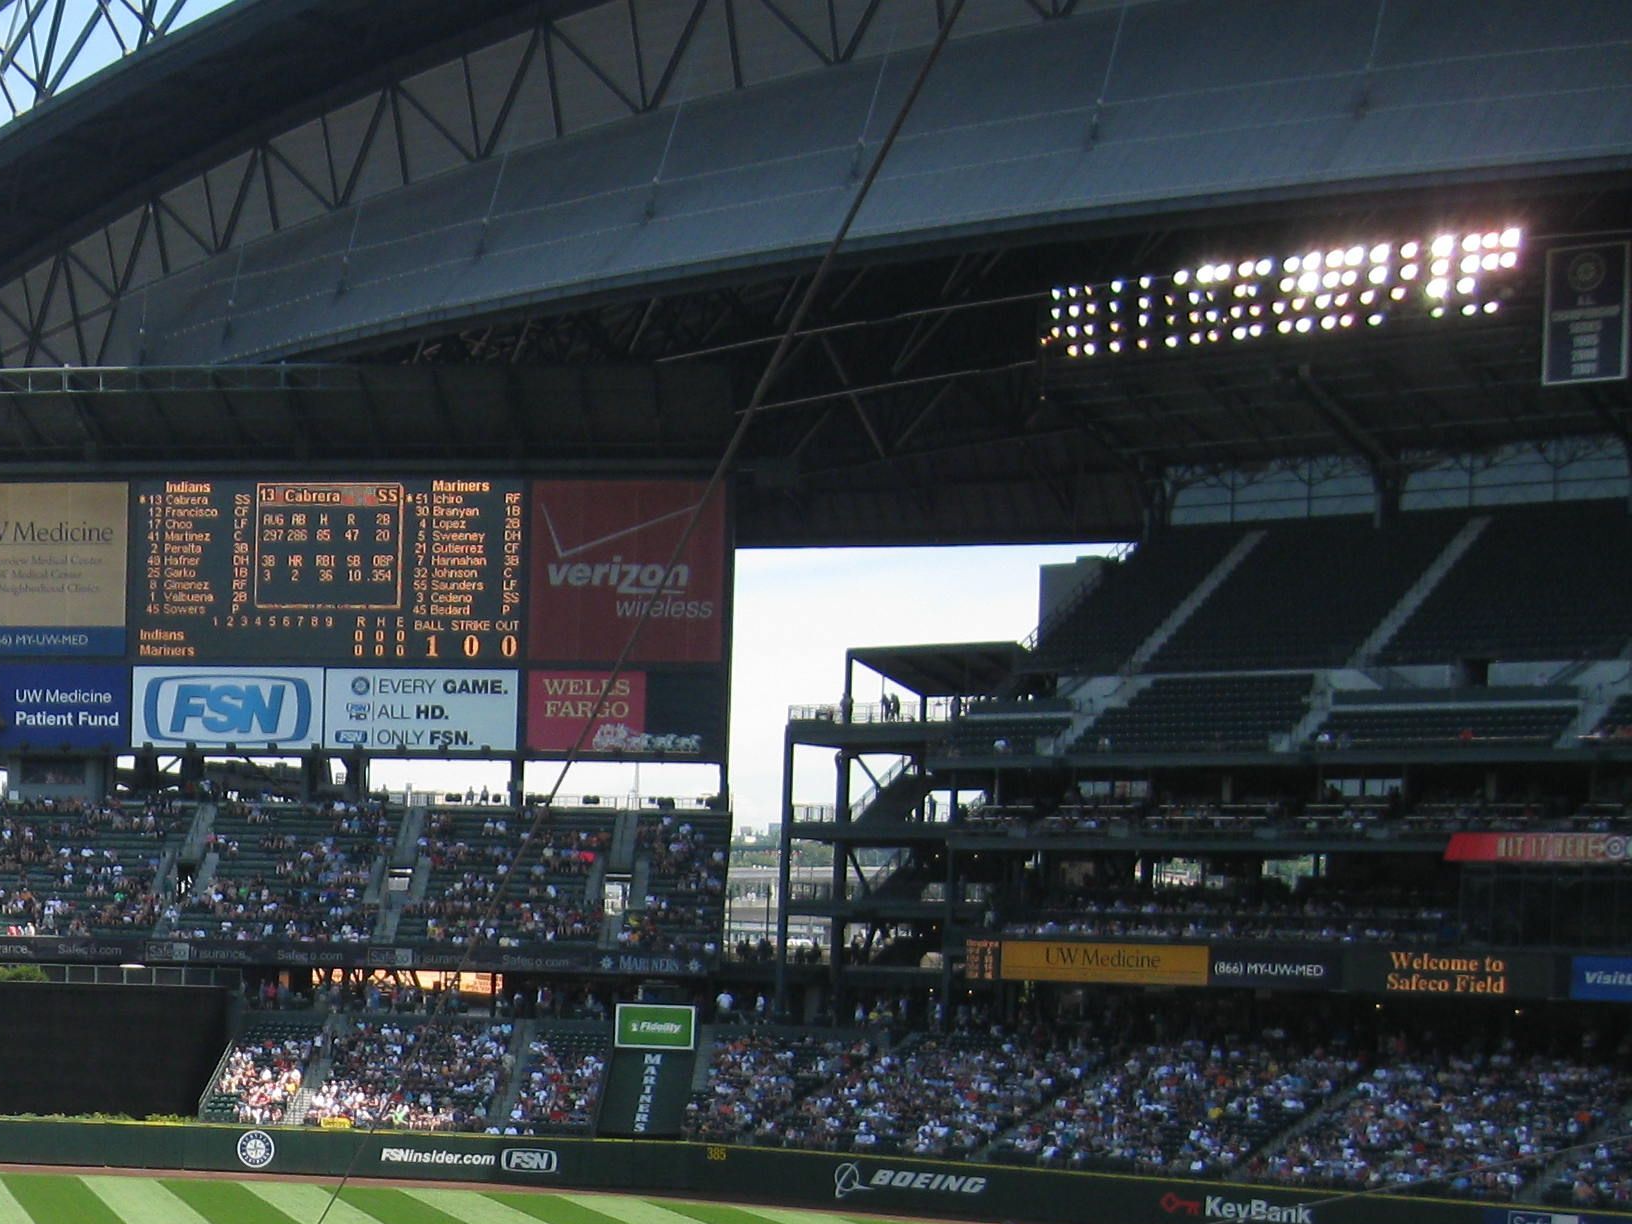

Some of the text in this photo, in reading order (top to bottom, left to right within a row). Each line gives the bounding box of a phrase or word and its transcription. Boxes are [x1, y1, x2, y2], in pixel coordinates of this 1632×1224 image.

[165, 481, 211, 493] Indians
[432, 480, 490, 492] Mariners
[260, 488, 398, 503] 13 Cabrera SS
[433, 493, 463, 504] Ichiro
[165, 507, 218, 517] Francisco
[432, 506, 479, 518] Branyan
[165, 519, 193, 529] Choo
[291, 514, 307, 526] AB
[432, 518, 466, 530] Lopez
[13, 521, 113, 542] Medicine
[164, 531, 211, 542] Martinez
[344, 529, 359, 541] 47
[375, 530, 390, 541] 20
[432, 531, 485, 542] Sweeney
[432, 543, 483, 554] Gutierrez
[164, 555, 200, 566] Hafner
[288, 555, 303, 567] HR
[315, 555, 336, 567] RBI
[346, 555, 361, 566] SB
[373, 555, 394, 566] OBP
[431, 555, 486, 566] Hannahan
[164, 568, 196, 578] Garko
[319, 570, 333, 581] 36
[348, 569, 362, 581] 10
[432, 568, 477, 579] Johnson
[547, 557, 690, 594] verizon
[431, 580, 484, 591] Saunders
[163, 604, 206, 614] Sowers
[430, 604, 470, 615] Bedard
[616, 597, 713, 618] wireless
[414, 620, 519, 631] BALL STRIKE OUT
[15, 634, 89, 646] MY-UW-MED
[140, 629, 184, 641] Indians
[140, 644, 194, 656] Mariners
[426, 635, 517, 657] 1 0 0
[379, 678, 508, 695] EVERY GAME.
[543, 678, 630, 696] WELLS
[16, 688, 112, 703] UW Medicine
[170, 684, 286, 734] FSN
[377, 704, 449, 720] ALL HD.
[544, 701, 629, 718] FARGO
[15, 711, 119, 726] Patient Fund
[377, 729, 473, 745] ONLY FSN.
[1045, 947, 1161, 969] UW Medicine
[1390, 952, 1505, 972] Welcome to
[1214, 961, 1324, 977] (866) MY-UW-MED
[1387, 973, 1505, 994] Safeco Field
[639, 1021, 682, 1034] Fidelity
[633, 1053, 662, 1132] MARINERS
[381, 1147, 549, 1170] FSNinsider.com FSN
[707, 1147, 727, 1161] 385
[870, 1168, 987, 1194] BOEING
